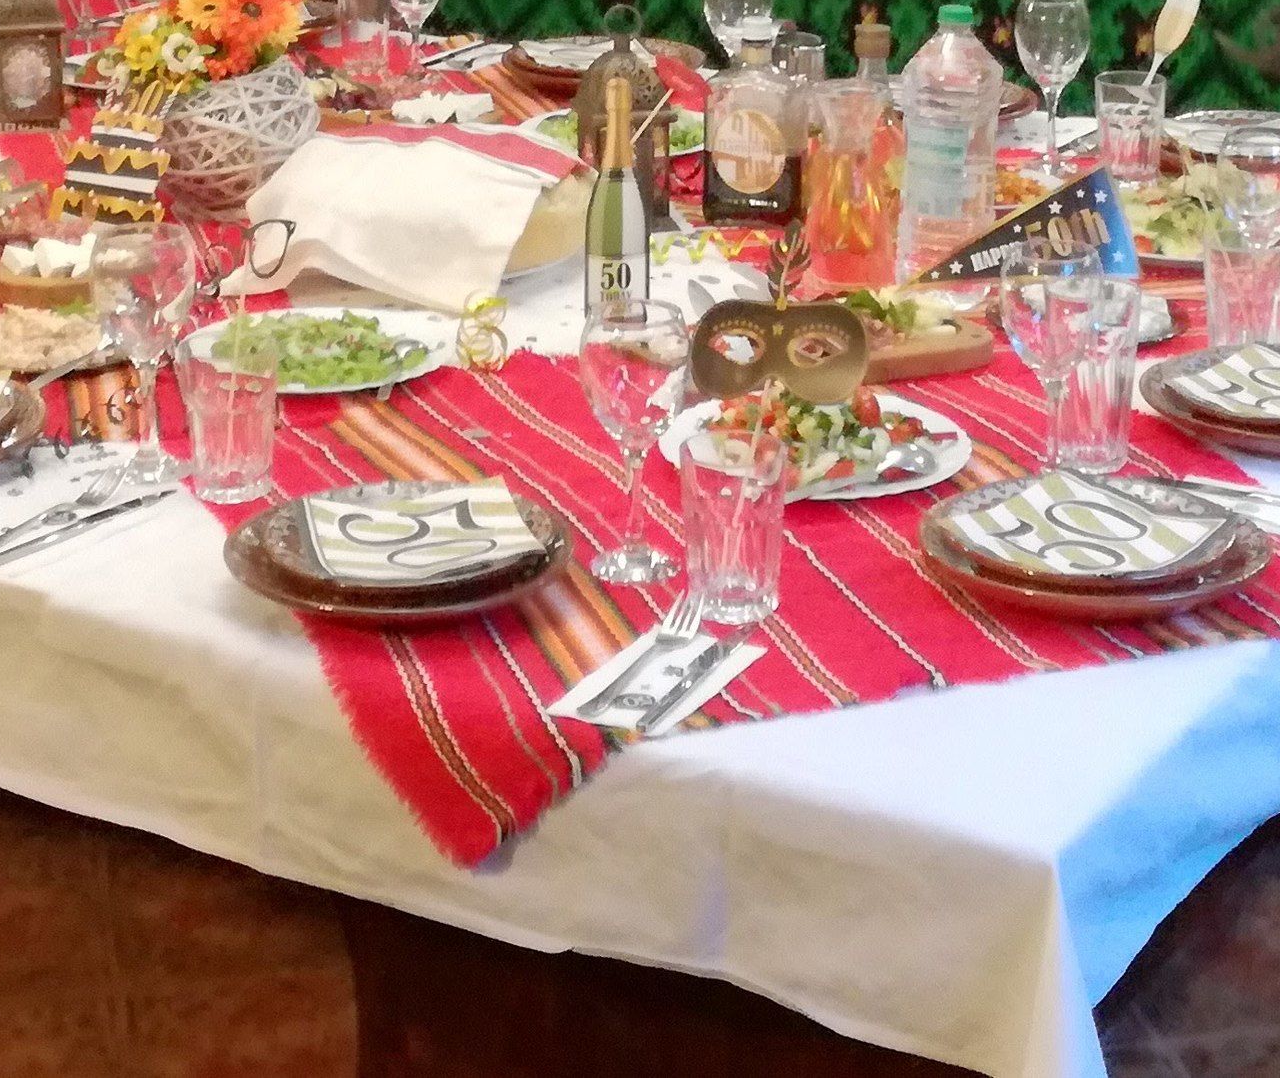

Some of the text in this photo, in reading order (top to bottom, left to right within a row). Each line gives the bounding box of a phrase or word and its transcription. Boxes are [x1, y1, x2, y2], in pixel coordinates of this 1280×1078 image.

[600, 262, 632, 290] 50
[337, 498, 498, 570] 50
[989, 499, 1149, 571] 50
